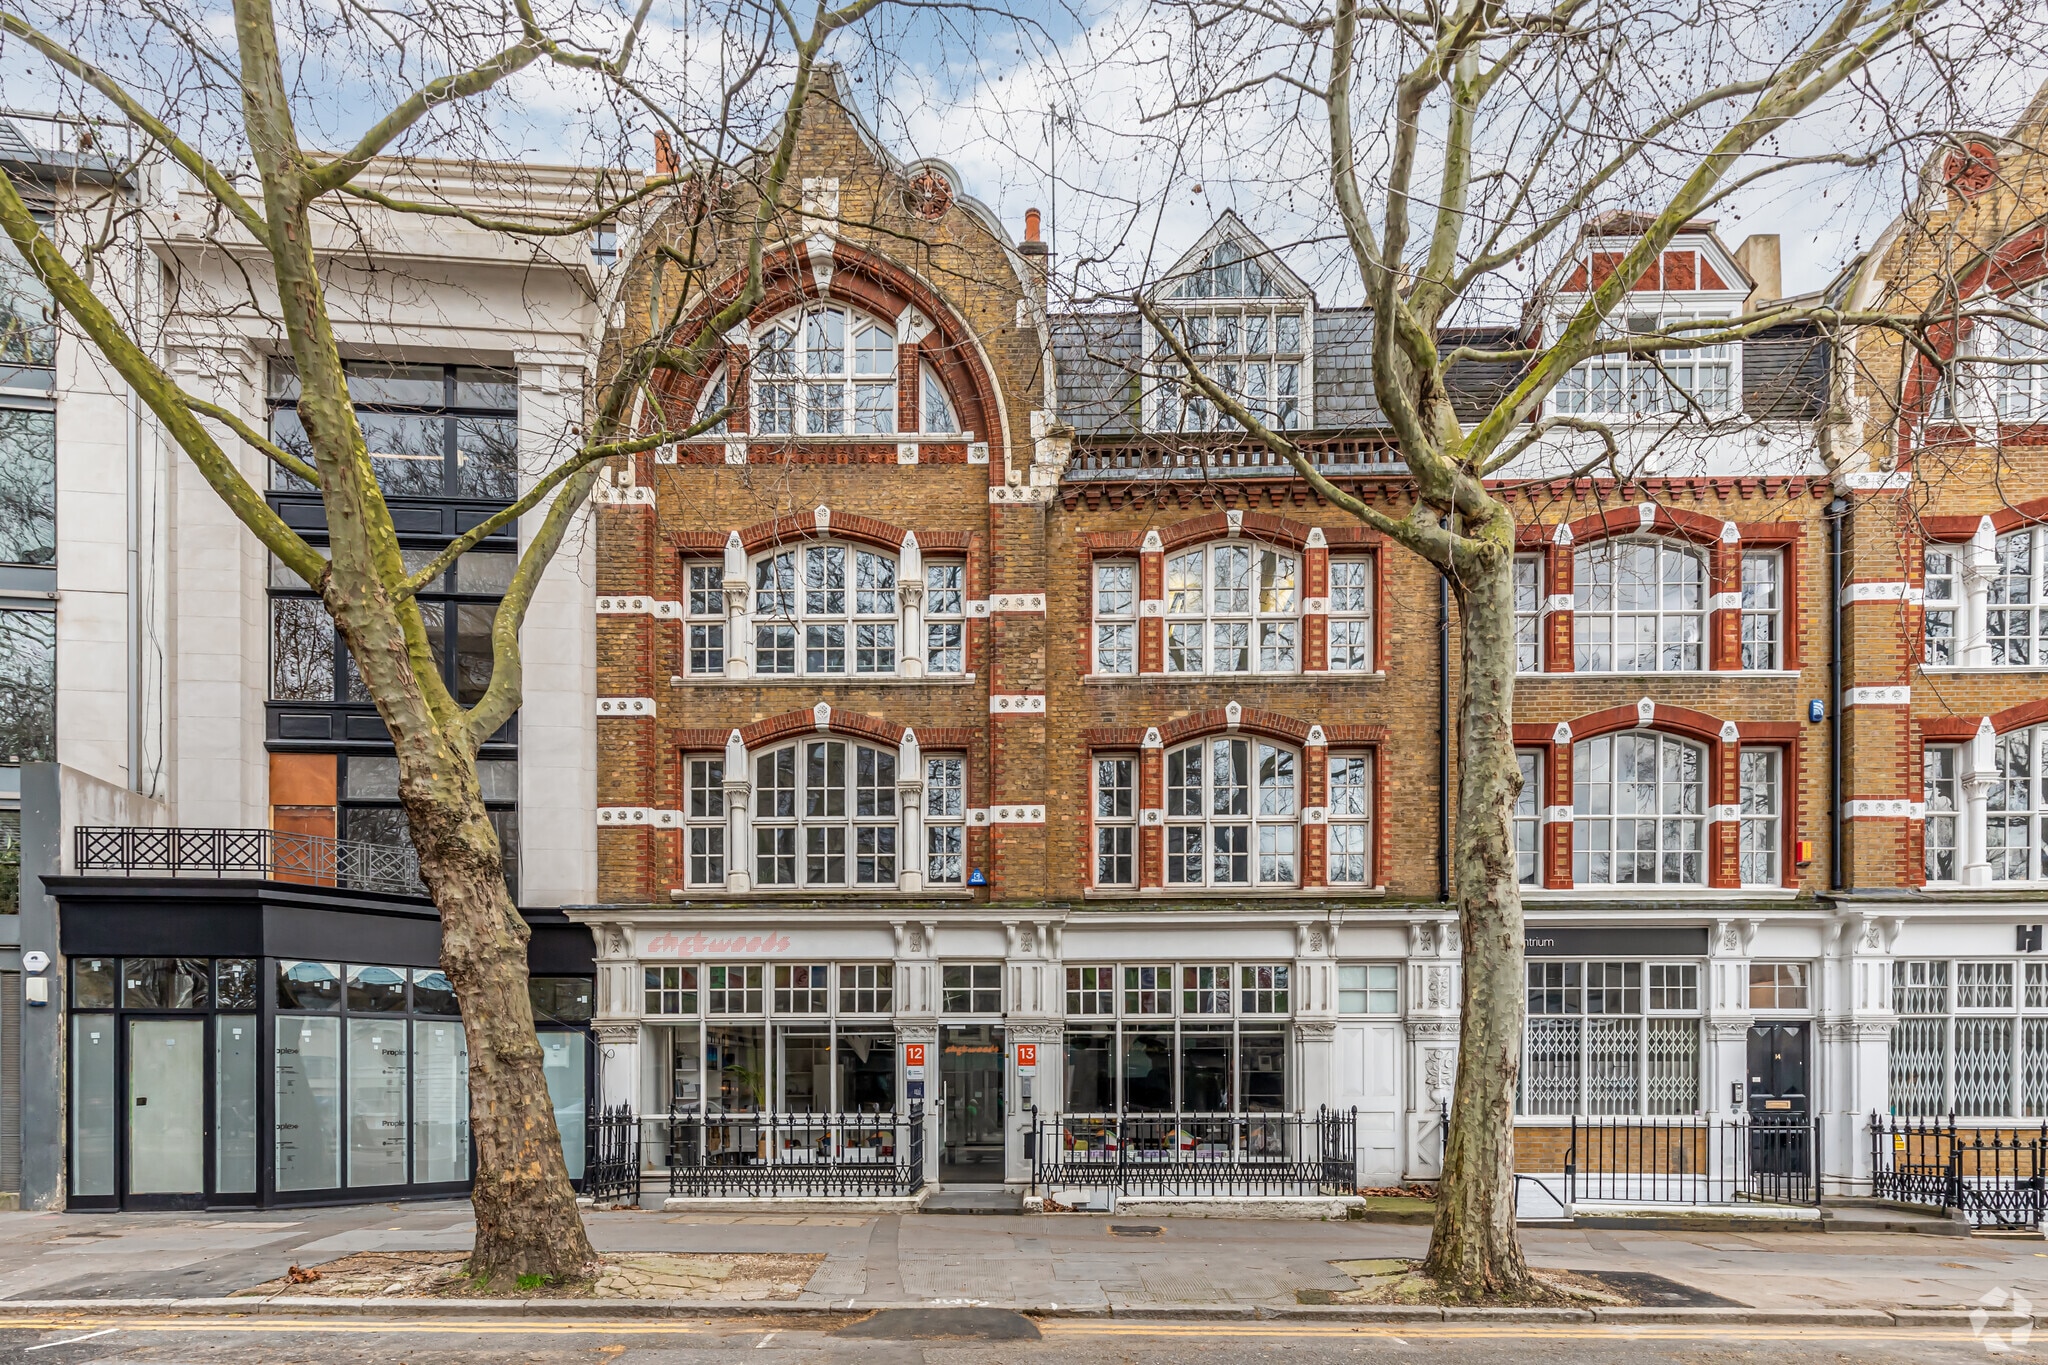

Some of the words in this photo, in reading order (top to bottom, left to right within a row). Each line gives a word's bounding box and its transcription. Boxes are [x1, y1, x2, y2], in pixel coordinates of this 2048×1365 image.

[648, 930, 791, 957] chetwoods
[908, 1047, 923, 1059] 12
[1019, 1047, 1035, 1059] 13
